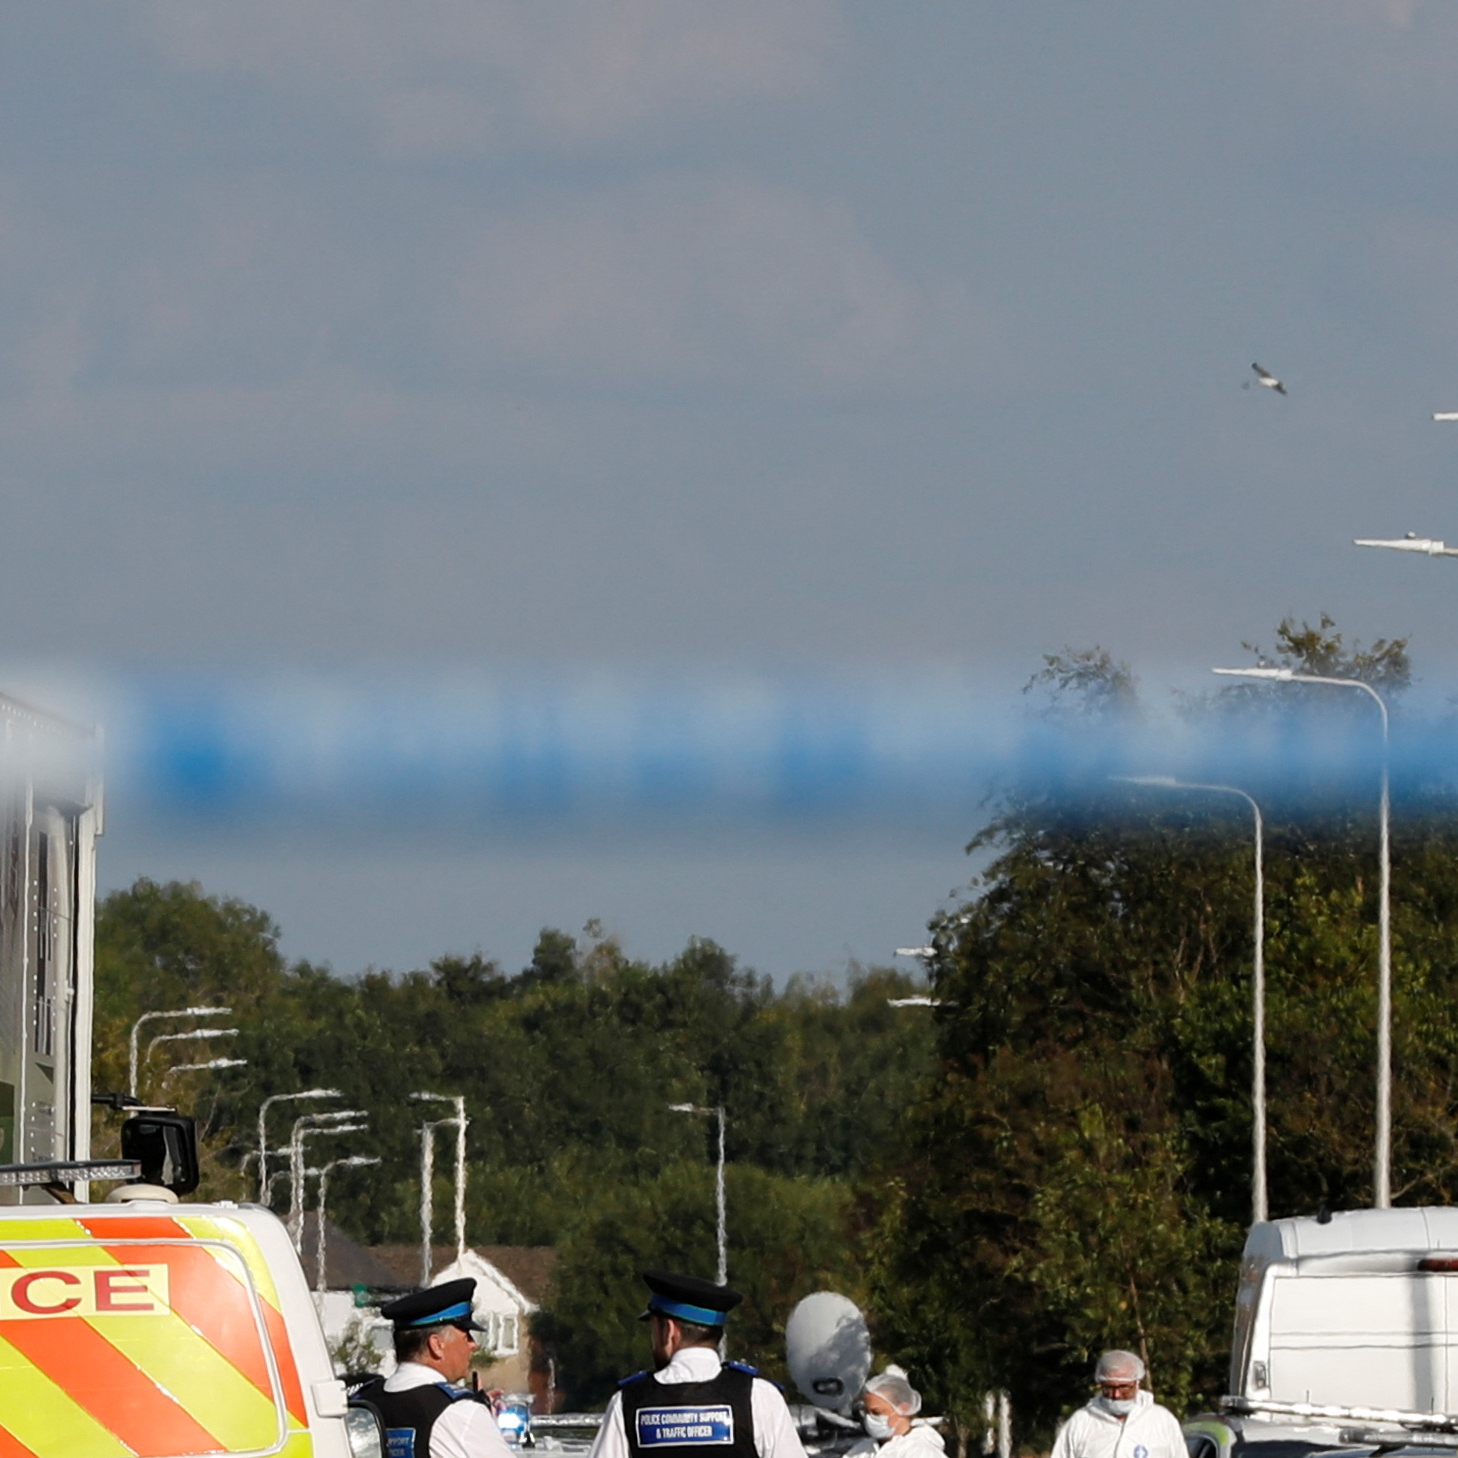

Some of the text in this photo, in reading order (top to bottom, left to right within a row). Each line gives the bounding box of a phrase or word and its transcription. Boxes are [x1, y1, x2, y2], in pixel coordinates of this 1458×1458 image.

[640, 1412, 660, 1426] POLICE
[662, 1426, 687, 1438] TRAFFIC
[687, 1425, 713, 1437] OFFICER
